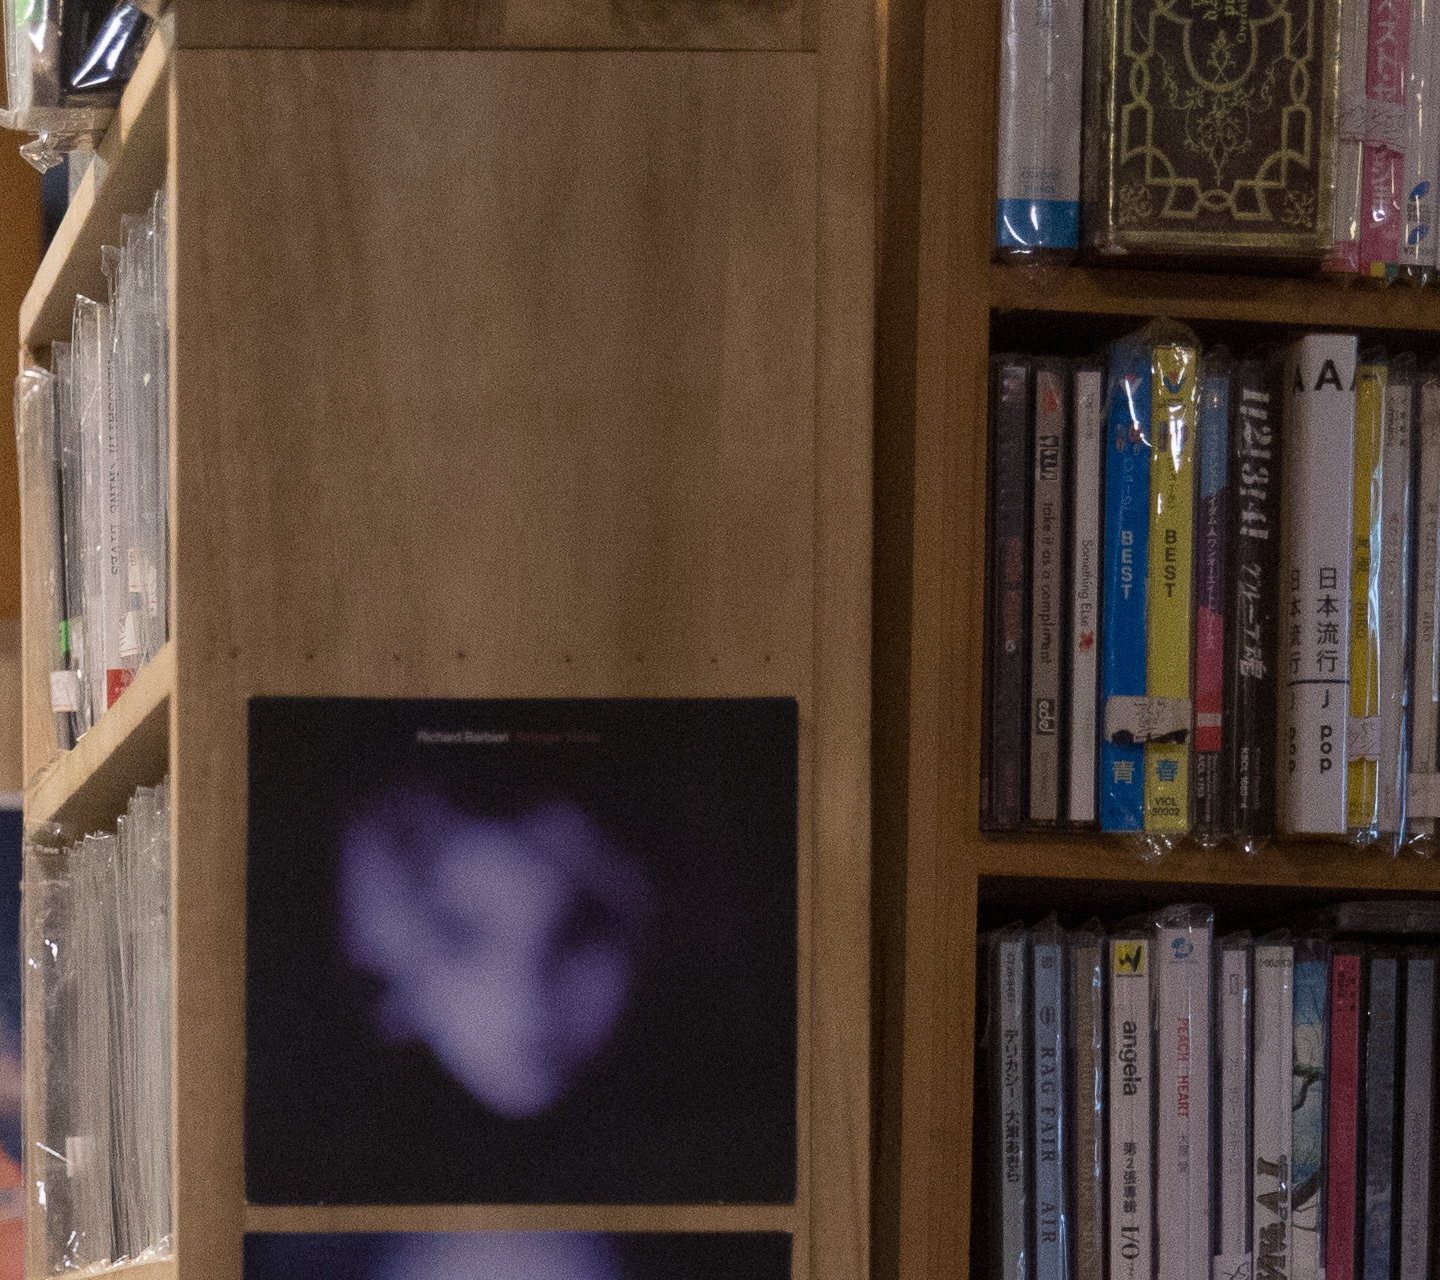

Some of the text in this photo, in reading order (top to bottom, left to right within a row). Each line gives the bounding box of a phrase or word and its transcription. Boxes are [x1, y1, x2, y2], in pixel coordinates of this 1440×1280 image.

[1314, 359, 1343, 391] A
[1078, 539, 1094, 599] Something
[1121, 531, 1134, 599] BEST
[1164, 529, 1177, 598] BEST
[1038, 584, 1053, 664] compliment
[1316, 566, 1339, 673] 日本流行
[1320, 724, 1333, 773] pop
[1176, 1018, 1189, 1118] PEACH HEART
[1040, 1047, 1056, 1245] RAG FAIR AIR
